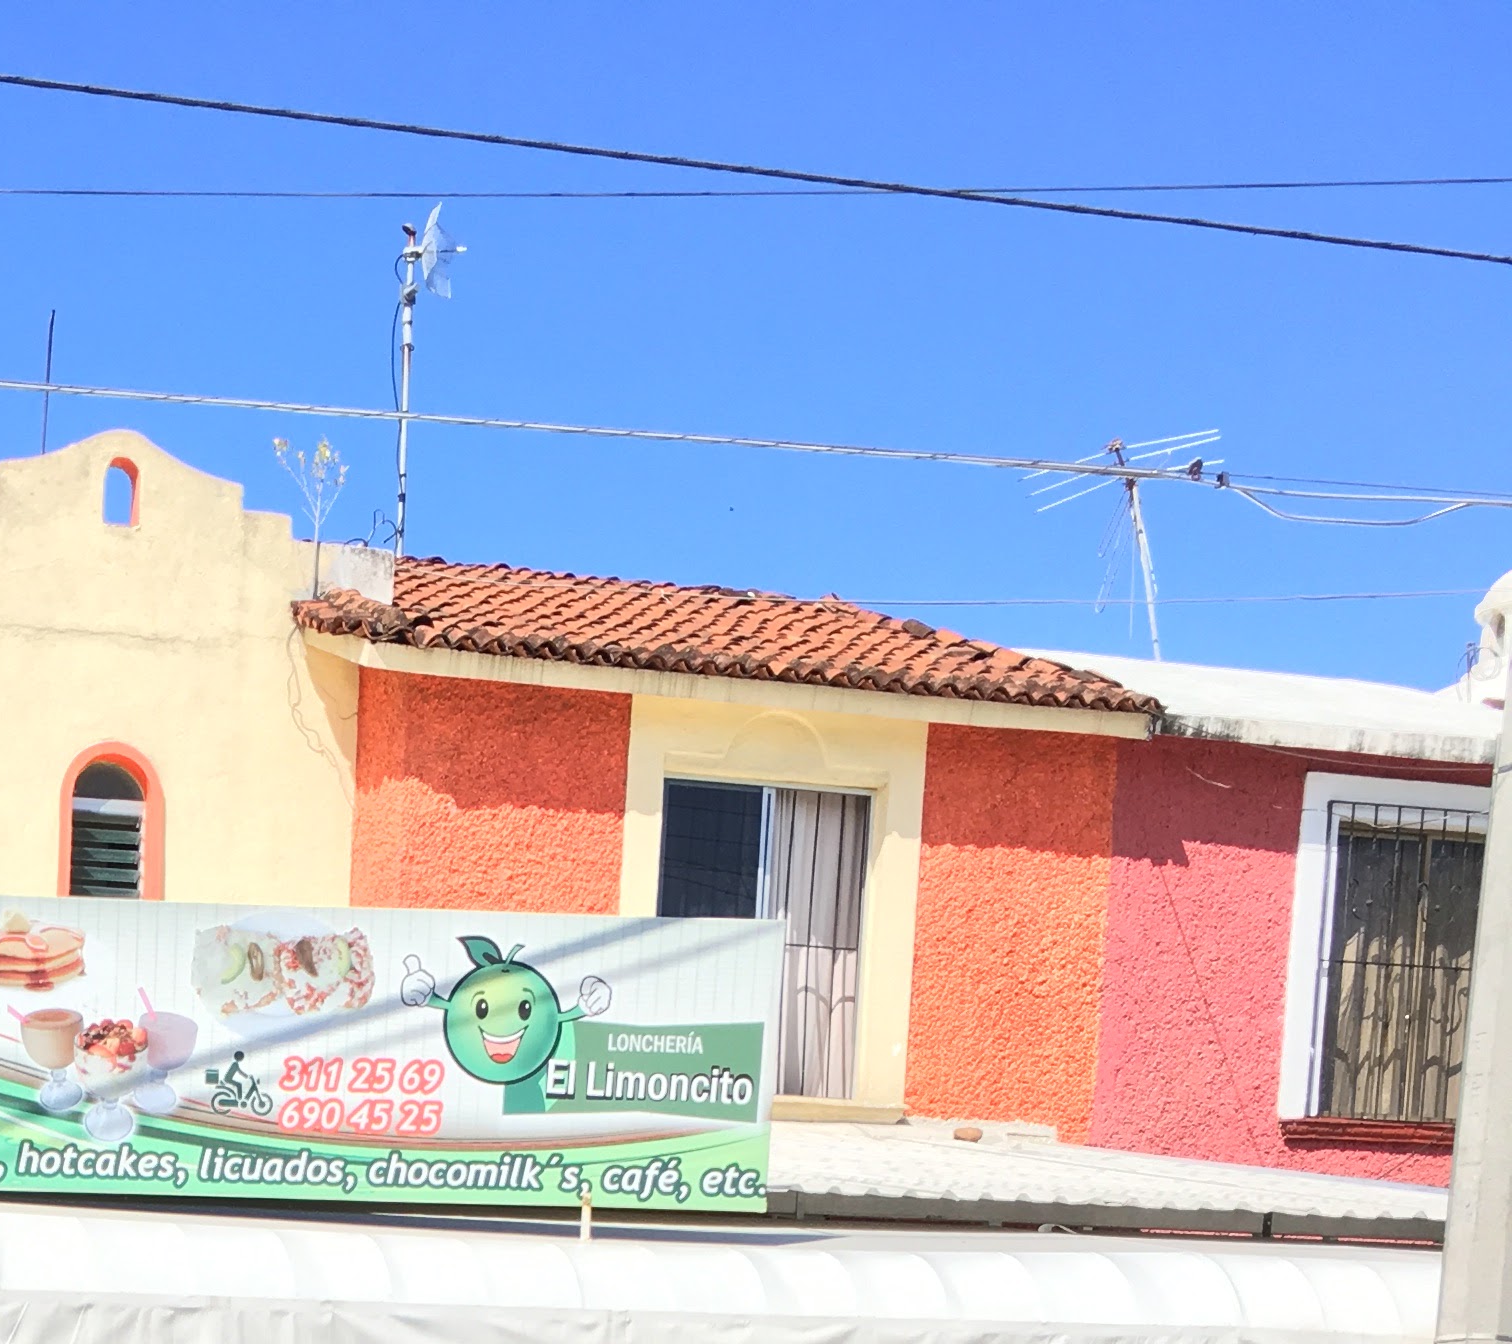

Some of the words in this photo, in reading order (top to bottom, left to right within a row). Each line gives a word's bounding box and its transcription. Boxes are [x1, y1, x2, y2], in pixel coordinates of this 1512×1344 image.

[608, 1031, 704, 1055] LONCHERÍA
[283, 1059, 342, 1088] 311
[352, 1061, 392, 1090] 25
[402, 1062, 441, 1092] 69
[546, 1058, 576, 1098] El
[587, 1061, 754, 1106] Limoncito
[281, 1100, 341, 1130] 690
[349, 1102, 390, 1132] 45
[399, 1103, 439, 1133] 25
[17, 1142, 187, 1186] hotcakes,
[199, 1147, 356, 1191] licuados,
[602, 1158, 689, 1201] café,
[701, 1166, 767, 1196] etc.
